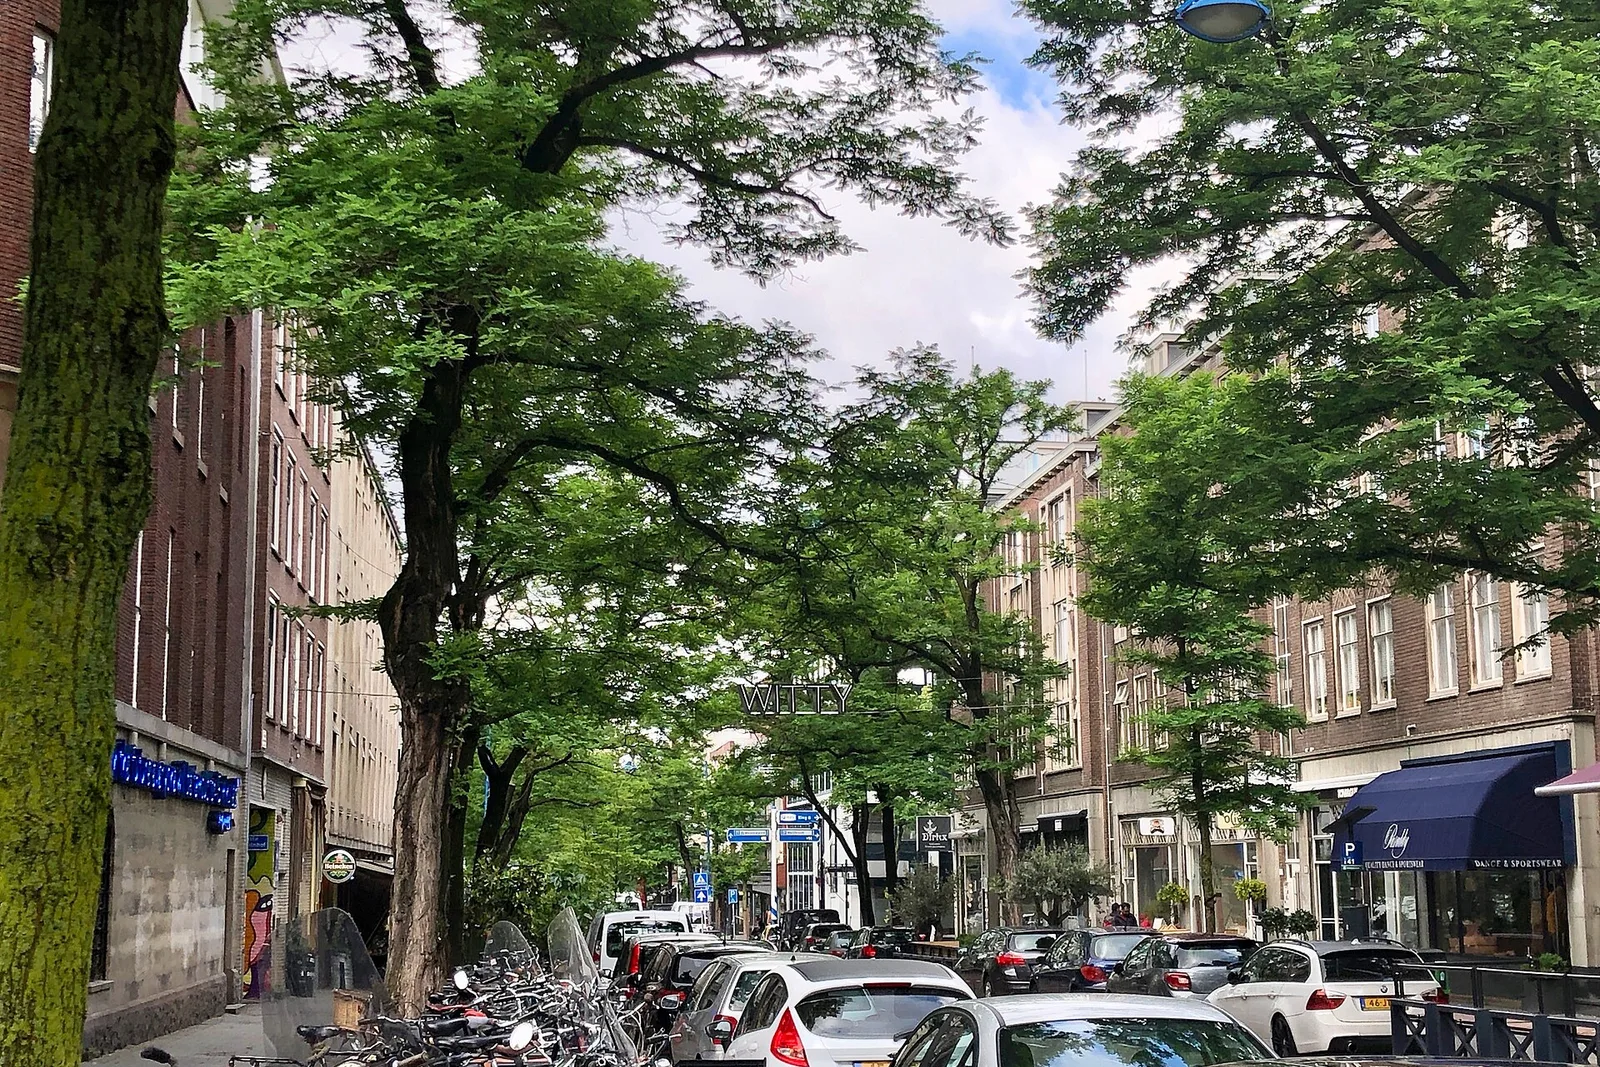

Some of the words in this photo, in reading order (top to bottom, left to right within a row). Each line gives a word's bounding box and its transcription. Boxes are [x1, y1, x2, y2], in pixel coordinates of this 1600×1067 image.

[740, 683, 852, 713] WITTY
[1345, 842, 1356, 856] P
[1474, 860, 1501, 868] DANCE
[1503, 860, 1509, 868] &
[1511, 860, 1562, 868] SPORTSWEAR
